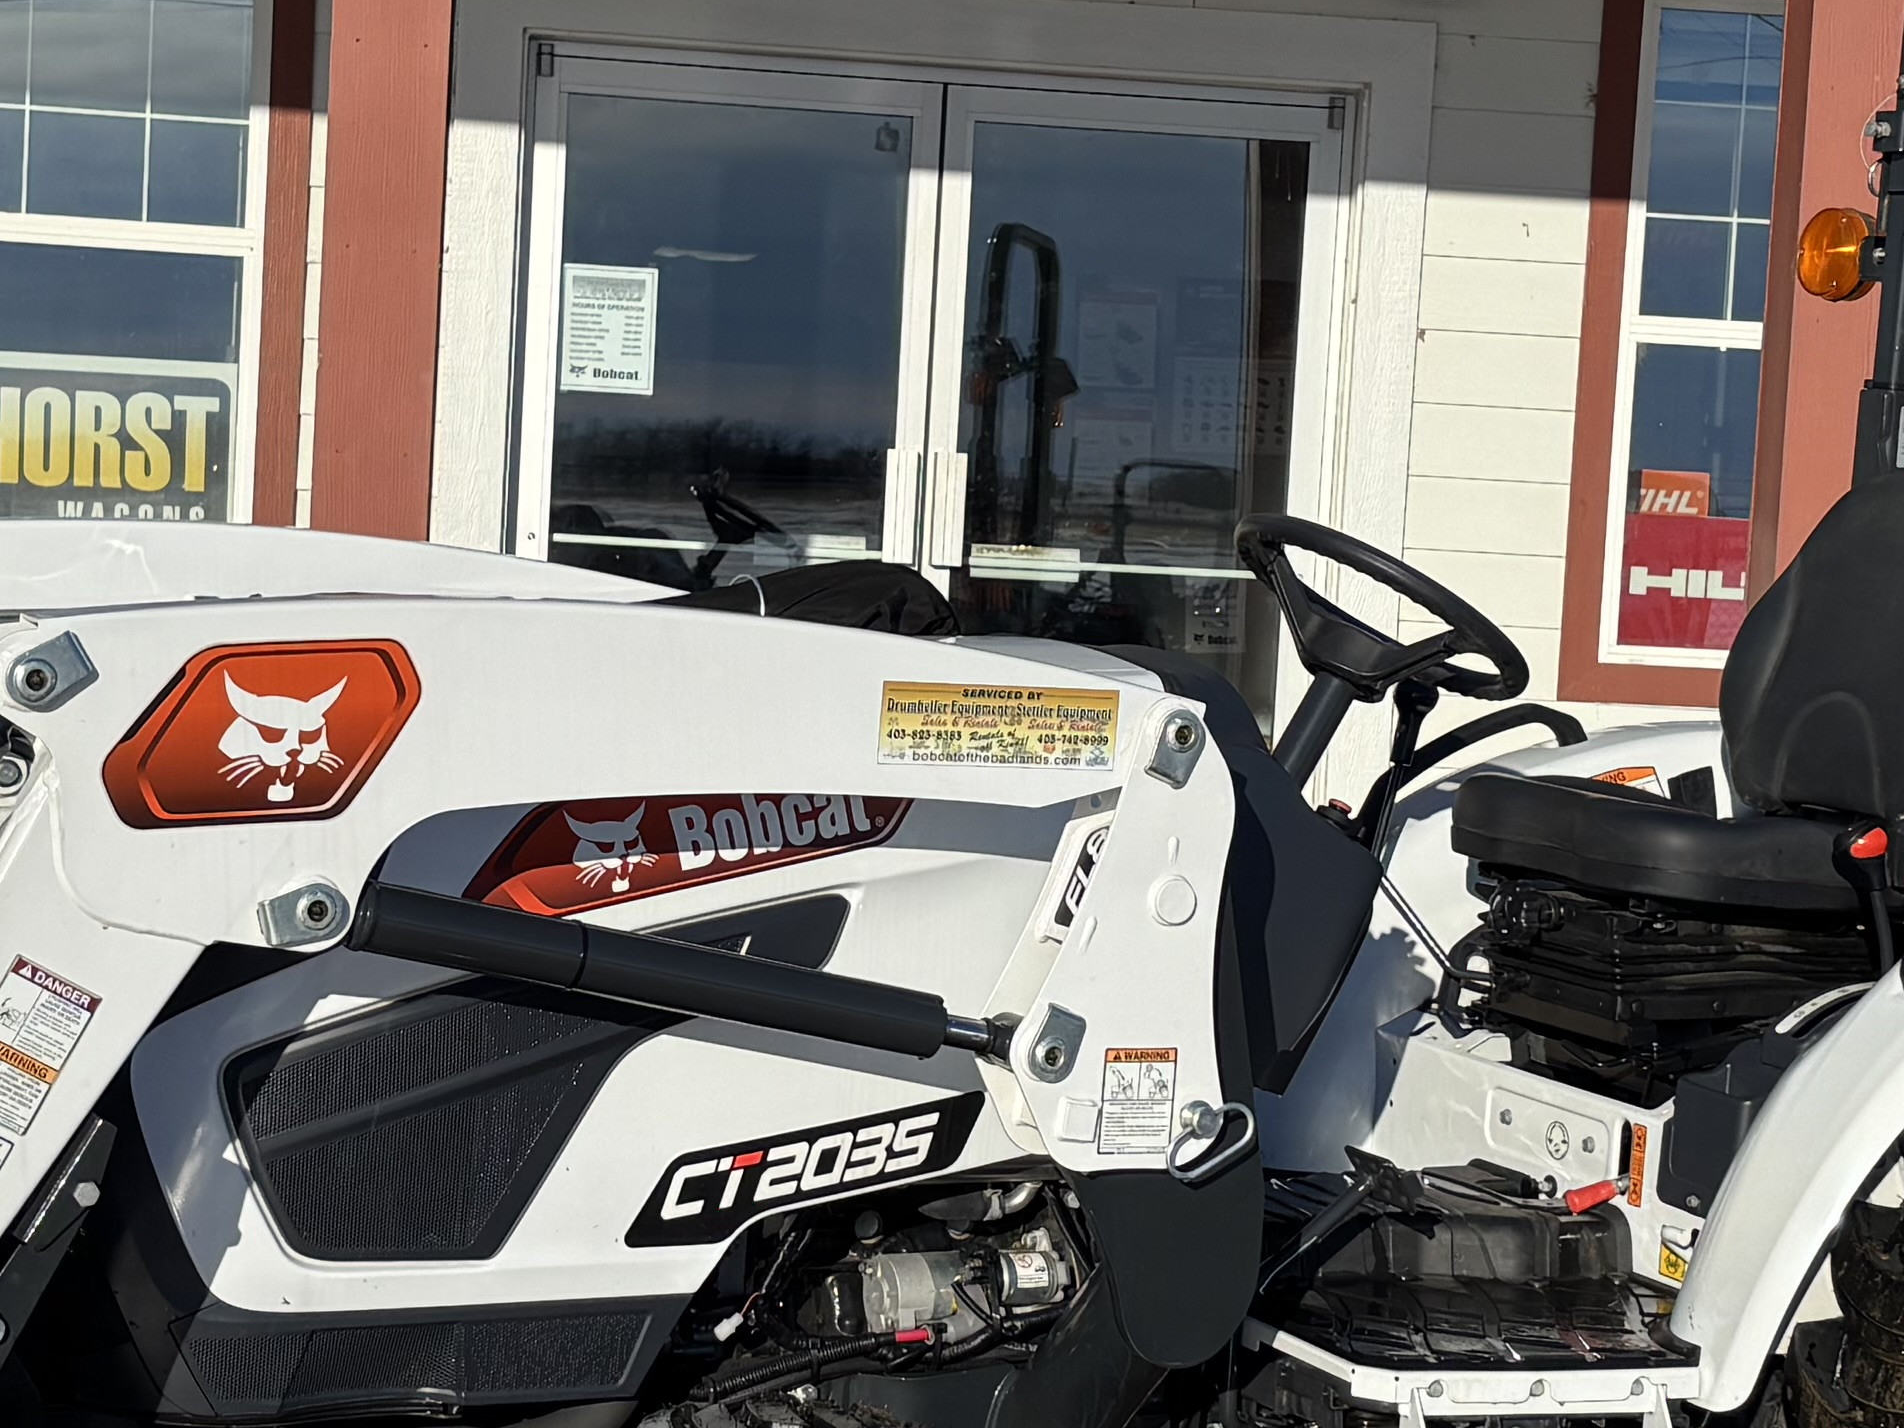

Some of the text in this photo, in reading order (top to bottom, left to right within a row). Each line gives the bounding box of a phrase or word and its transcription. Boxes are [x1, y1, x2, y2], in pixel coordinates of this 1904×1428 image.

[593, 367, 639, 380] Bobcat
[1629, 565, 1746, 601] HIL
[961, 688, 1044, 701] SERVICED BY
[887, 697, 1009, 721] Drumheller Equipment
[1015, 703, 1112, 722] Stettler Equipment
[912, 750, 1081, 767] bobcatofthebadlands.com
[667, 793, 871, 871] Bobcat
[33, 970, 92, 1009] DANGER
[1124, 1051, 1170, 1060] WARNING
[660, 1112, 940, 1220] CT2035
